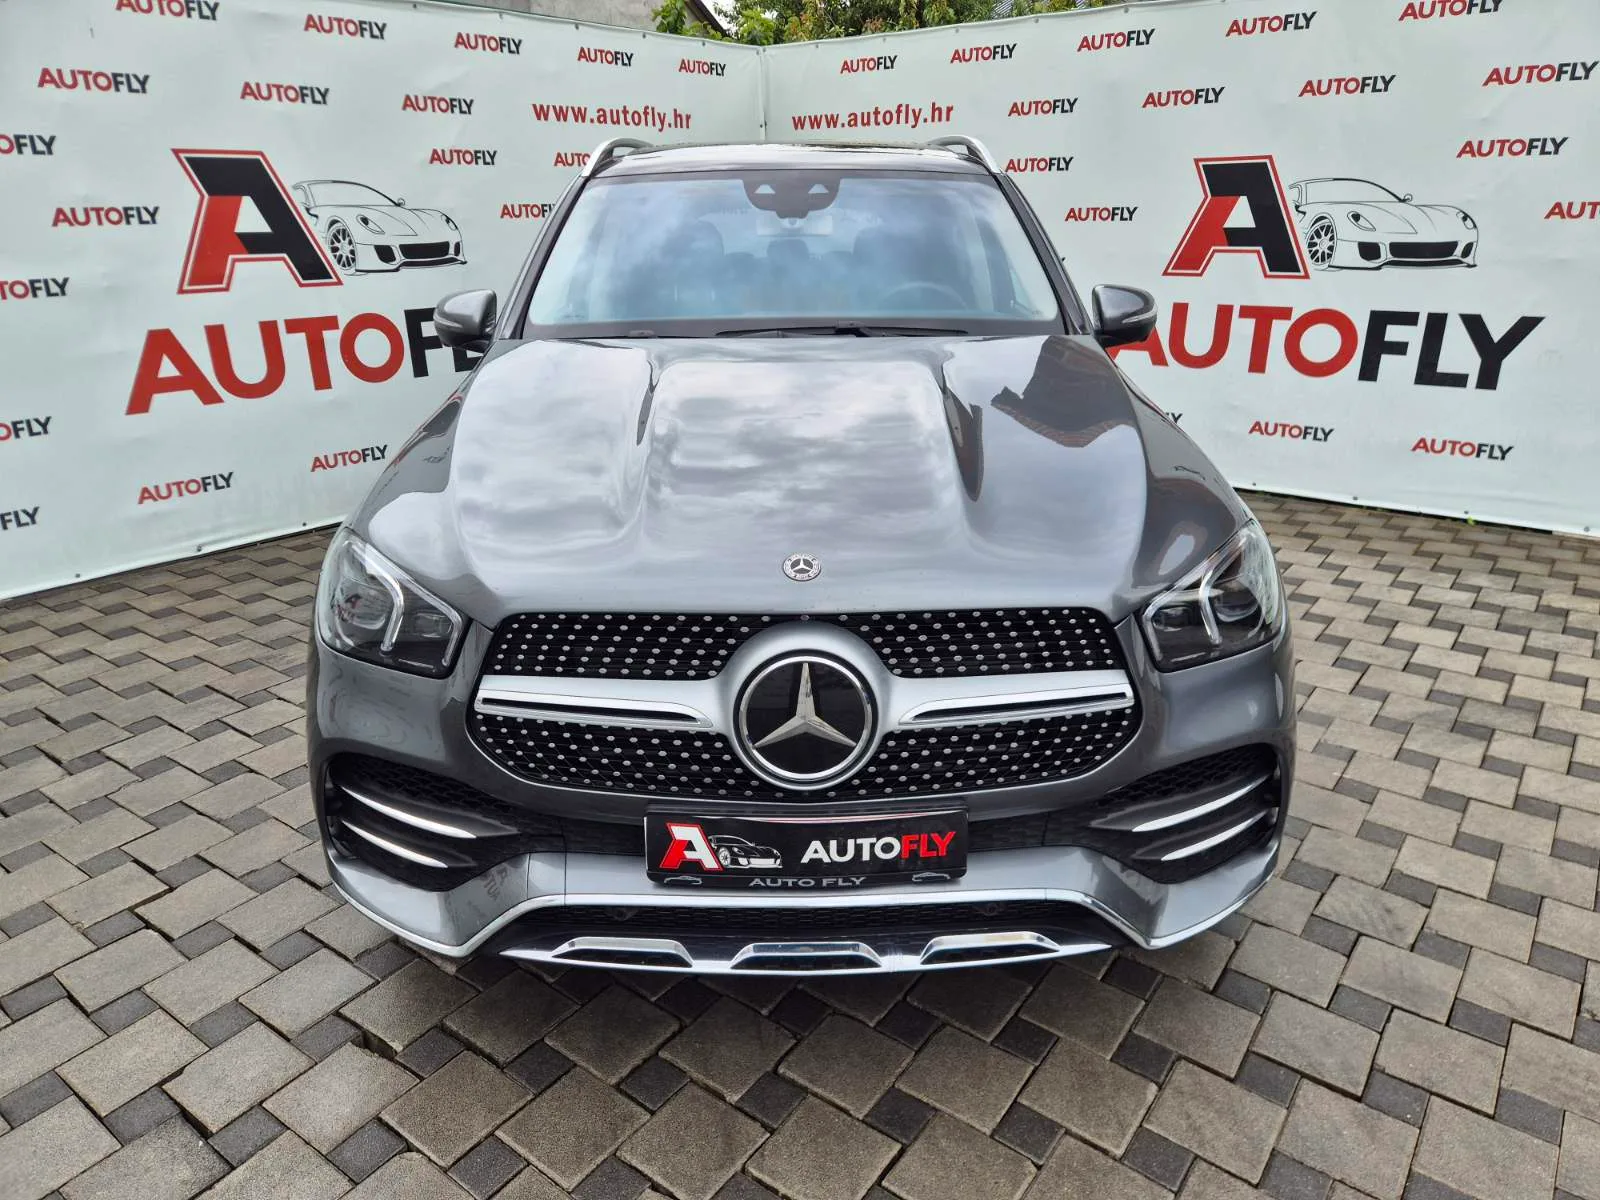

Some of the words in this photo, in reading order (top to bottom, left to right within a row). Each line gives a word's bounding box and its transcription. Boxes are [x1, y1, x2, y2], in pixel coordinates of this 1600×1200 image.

[1398, 0, 1502, 21] AUTOFLY
[304, 14, 387, 39] AUTOFLY
[1226, 11, 1317, 37] AUTOFLY
[454, 32, 522, 55] AUTOFLY
[1077, 28, 1155, 52] AUTOFLY
[577, 47, 634, 67] AUTOFLY
[839, 55, 898, 74] AUTOFLY
[950, 43, 1017, 64] AUTOFLY
[677, 59, 727, 77] AUTOFLY
[1482, 61, 1599, 87] AUTOFLY
[37, 67, 150, 94] AUTOFLY
[1299, 74, 1396, 98] AUTOFLY
[240, 82, 330, 105] AUTOFLY
[403, 95, 474, 115] AUTOFLY
[1142, 86, 1225, 110] AUTOFLY
[531, 103, 692, 132] www.autofly.hr
[792, 102, 954, 130] www.autofly.hr
[1007, 98, 1078, 118] AUTOFLY
[428, 148, 497, 166] AUTOFLY
[1456, 137, 1569, 159] AUTOFLY
[1005, 156, 1074, 173] AUTOFLY
[52, 206, 160, 227] AUTOFLY
[1064, 206, 1139, 223] AUTOFLY
[1249, 420, 1335, 443] AUTOFLY
[310, 444, 388, 472] AUTOFLY
[1411, 437, 1514, 461] AUTOFLY
[138, 471, 234, 505] AUTOFLY
[800, 831, 957, 864] AUTOFLY
[748, 877, 816, 888] AUTO
[822, 876, 867, 887] FLY
